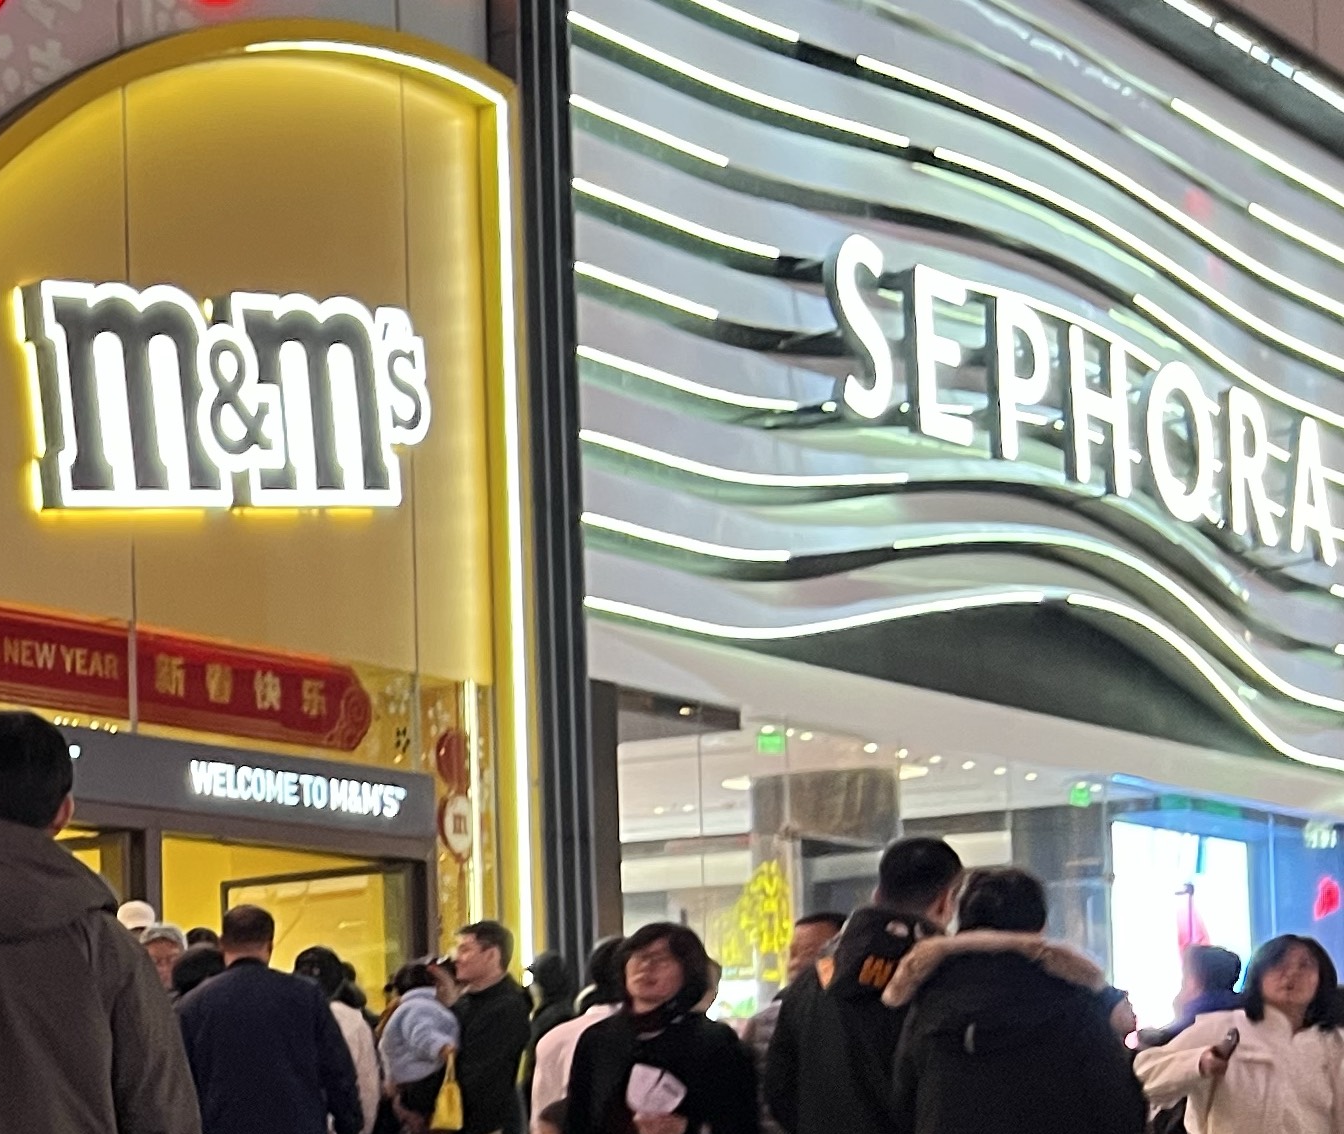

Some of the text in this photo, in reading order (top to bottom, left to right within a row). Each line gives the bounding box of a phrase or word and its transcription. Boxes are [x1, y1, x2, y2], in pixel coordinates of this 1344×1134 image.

[827, 234, 1337, 567] SEPHORA
[3, 635, 58, 671] NEW
[59, 644, 120, 680] YEAR
[189, 759, 300, 806] WELCOME
[299, 773, 329, 810] TO
